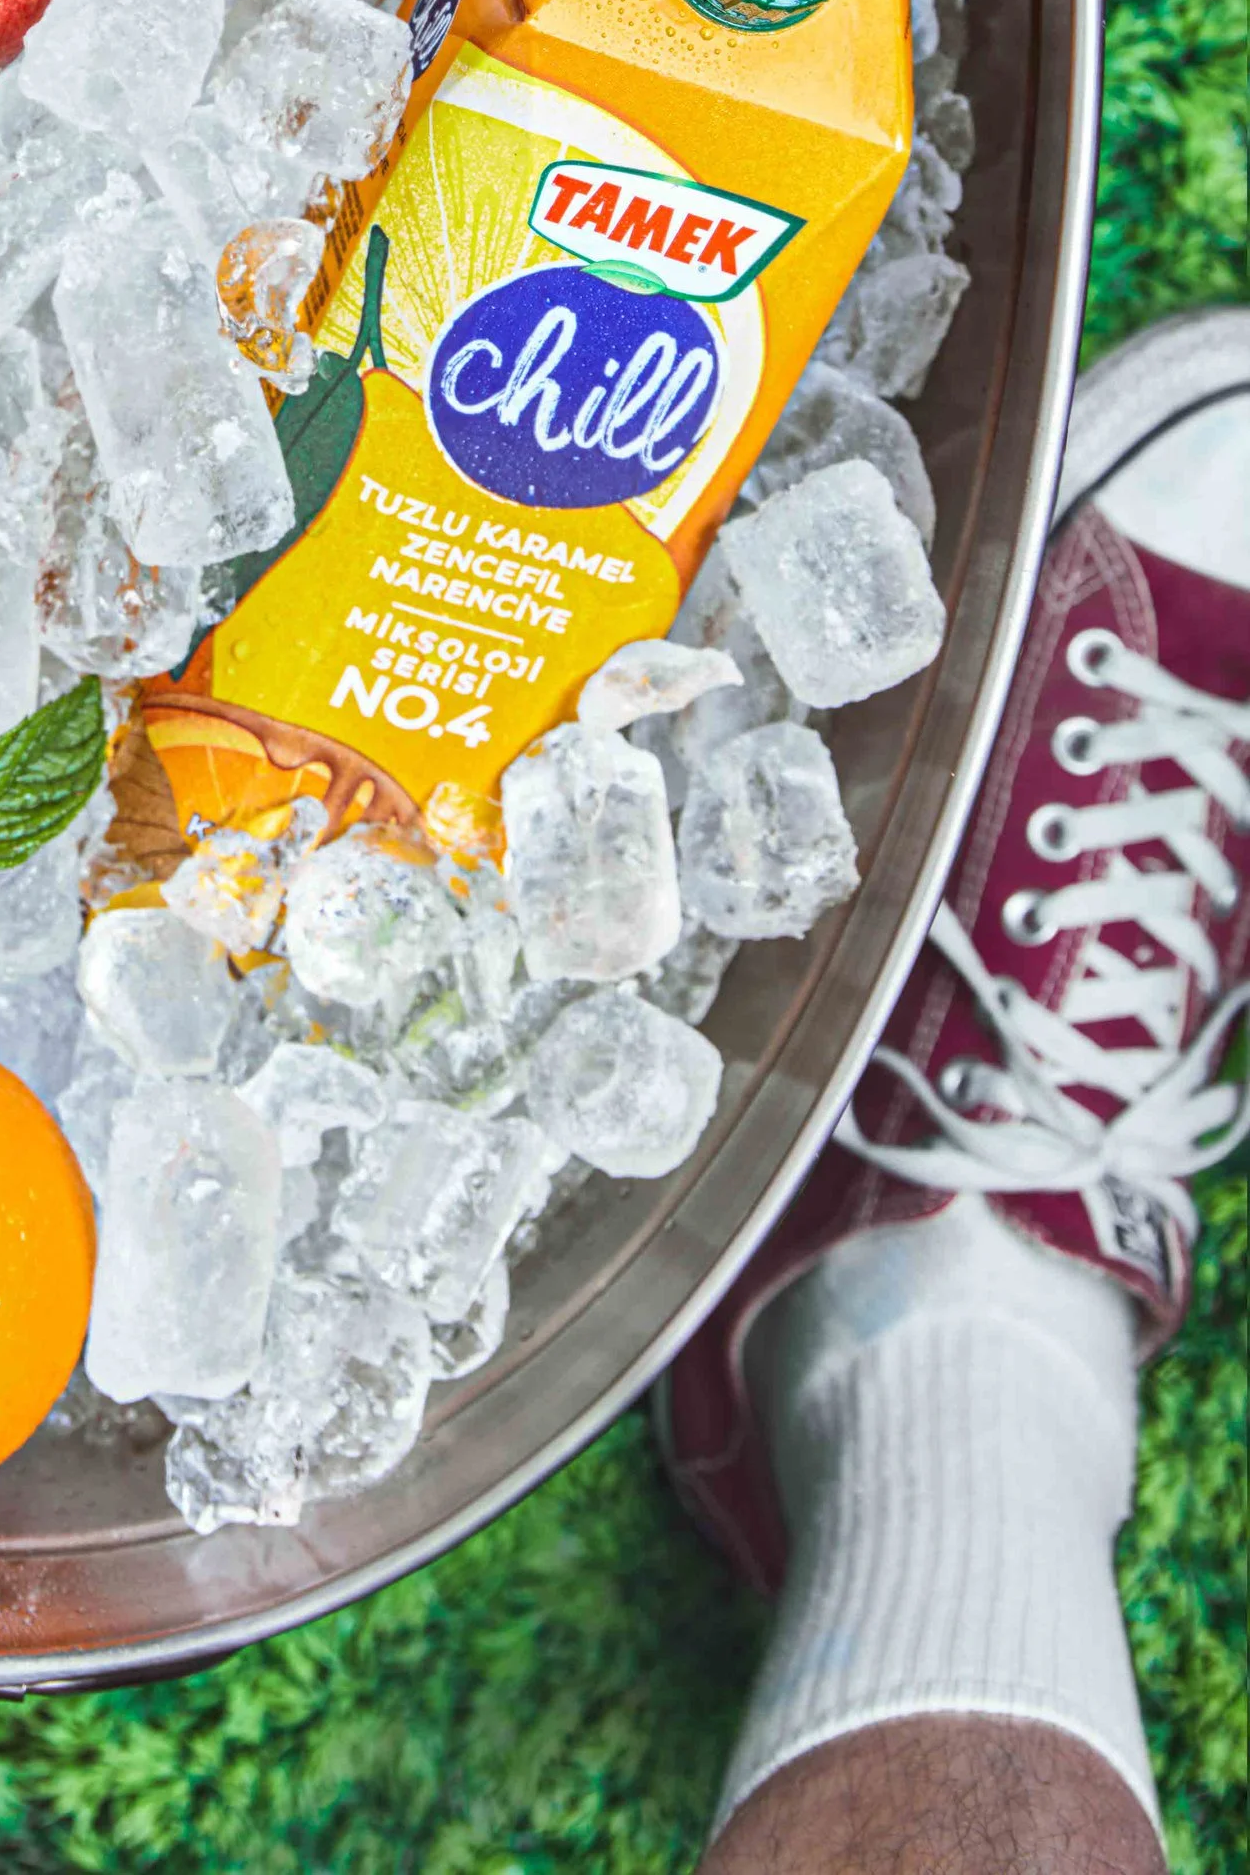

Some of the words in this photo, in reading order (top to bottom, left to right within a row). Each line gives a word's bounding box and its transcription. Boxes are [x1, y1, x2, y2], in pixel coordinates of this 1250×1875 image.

[544, 175, 759, 276] TAMEK
[441, 305, 716, 472] chill
[357, 475, 472, 547] TUZLU
[474, 519, 636, 586] KARAMEL
[369, 559, 573, 634] NARENCİYE
[345, 605, 545, 684] MİKSOLOJİ
[370, 647, 494, 700] SERİSİ
[329, 665, 492, 749] NO.4
